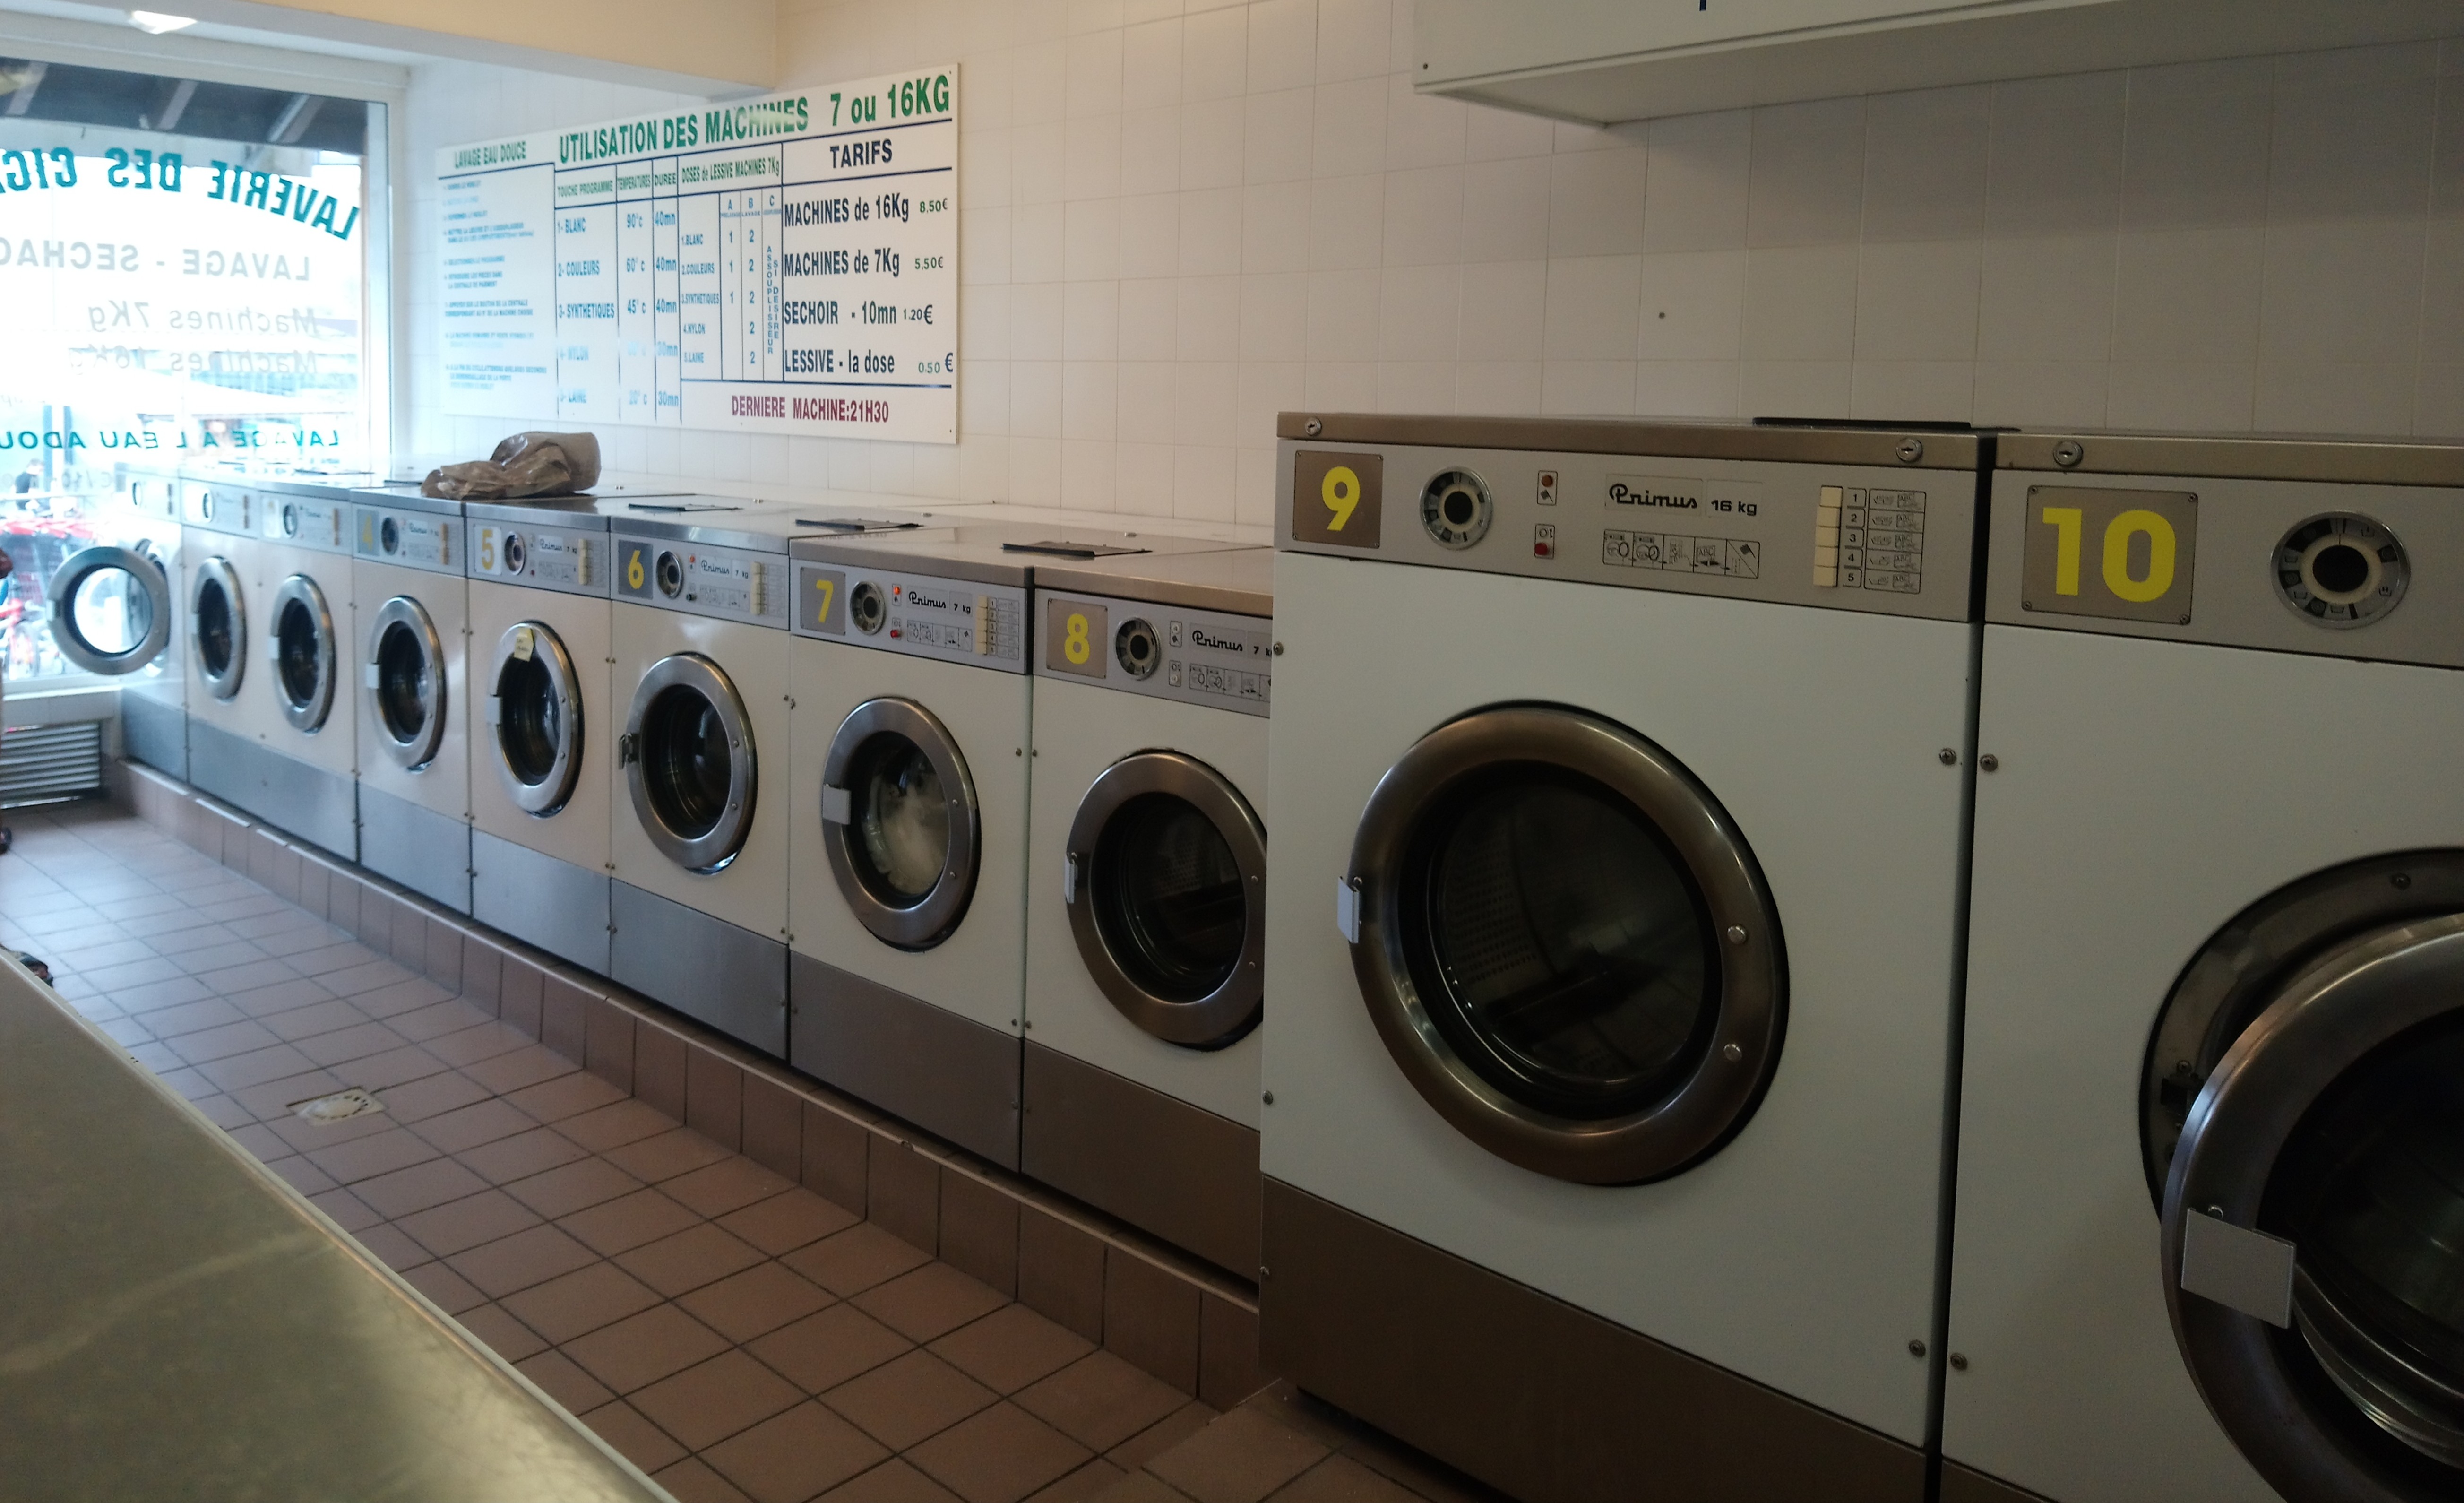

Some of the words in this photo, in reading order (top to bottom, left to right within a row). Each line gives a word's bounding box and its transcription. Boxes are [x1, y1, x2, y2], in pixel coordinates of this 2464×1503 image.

[560, 119, 658, 164] UTILISATION
[663, 113, 698, 149] DES
[706, 96, 809, 144] MACHINES
[830, 92, 842, 127] 7
[851, 95, 877, 124] ou
[887, 74, 950, 119] 16KG
[455, 148, 481, 169] LAVAGE
[483, 145, 497, 164] EAU
[500, 140, 526, 162] DOUCE
[830, 139, 893, 169] TARIFS
[682, 165, 700, 183] DOSES
[702, 167, 708, 181] de
[710, 162, 733, 181] LESSIVE
[735, 157, 766, 178] MACHINES
[768, 155, 780, 177] 7Kg
[617, 173, 651, 190] TEMPERATURES
[654, 173, 676, 186] DUREE
[558, 184, 578, 198] TOUCHE
[579, 180, 613, 195] PROGRAMME
[728, 199, 733, 210] A
[749, 197, 754, 208] B
[769, 195, 775, 207] C
[784, 197, 850, 227] MACHINES
[854, 196, 870, 221] de
[876, 192, 909, 223] 16Kg
[565, 216, 586, 234] BLANC
[655, 211, 676, 226] 40mn
[729, 230, 733, 243] 1
[749, 229, 755, 243] 2
[566, 259, 600, 276] COULEURS
[655, 256, 677, 271] 40mn
[729, 260, 733, 273] 1
[749, 259, 755, 272] 2
[784, 250, 849, 277] MACHINES
[854, 249, 869, 273] de
[874, 247, 900, 278] 7Kg
[730, 291, 734, 304] 1
[750, 290, 755, 304] 2
[567, 303, 615, 319] SYNTHETIQUES
[656, 298, 677, 314] 40mn
[784, 300, 838, 325] SECHOIR
[862, 300, 897, 324] 10mn
[750, 322, 755, 335] 2
[750, 351, 756, 364] 2
[784, 349, 834, 373] LESSIVE
[849, 349, 859, 373] la
[865, 349, 895, 374] dose
[658, 391, 679, 407] 30mn
[732, 394, 786, 419] DERNIERE
[793, 397, 890, 424] MACHINE:21H30
[1322, 466, 1361, 531] 9
[1608, 483, 1699, 509] Primus
[1711, 499, 1732, 513] 16
[1738, 501, 1758, 516] kg
[1852, 493, 1858, 503] 1
[1850, 513, 1857, 523] 2
[362, 514, 373, 551] 4
[1849, 533, 1857, 543] 3
[481, 529, 494, 570] 5
[1847, 553, 1854, 562] 4
[2042, 506, 2177, 603] 10
[628, 549, 645, 590] 6
[700, 559, 730, 575] Primus
[742, 569, 749, 579] kg
[1847, 573, 1854, 582] 5
[816, 579, 834, 623] 7
[908, 591, 947, 609] Primus
[954, 603, 959, 612] 7
[962, 603, 971, 614] kg
[1064, 613, 1090, 665] 8
[1192, 630, 1243, 652] Primus
[1253, 646, 1259, 655] 7
[1266, 647, 1272, 659] k
